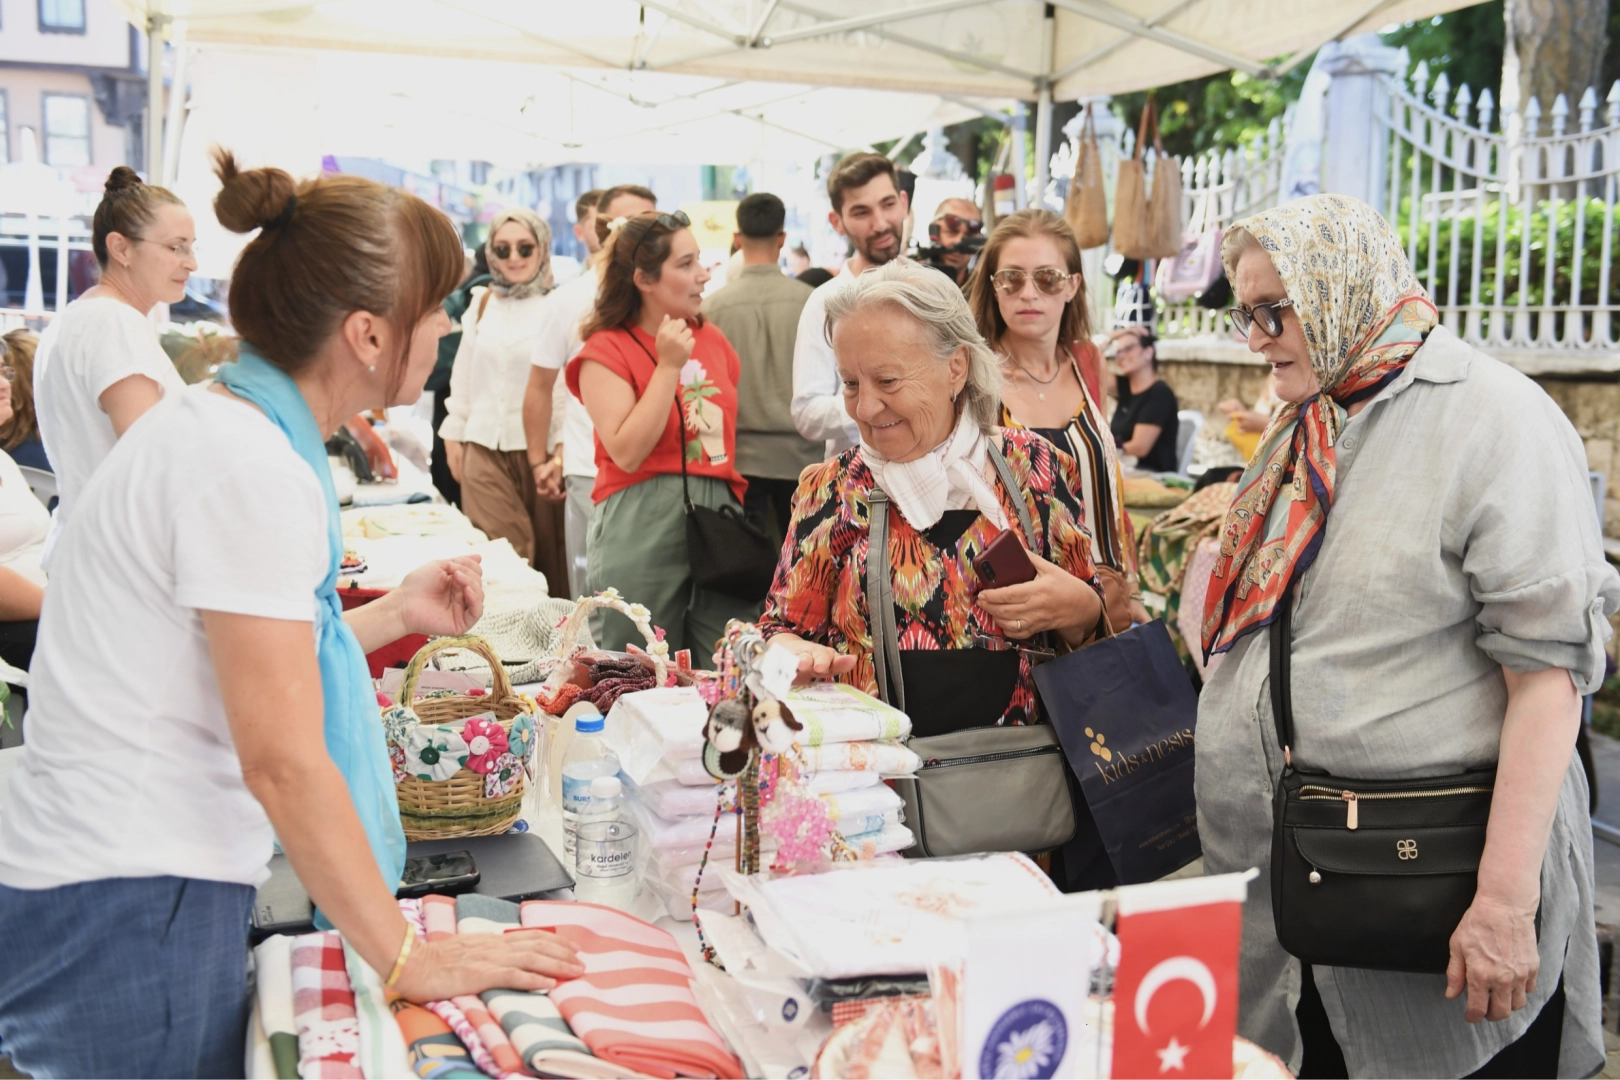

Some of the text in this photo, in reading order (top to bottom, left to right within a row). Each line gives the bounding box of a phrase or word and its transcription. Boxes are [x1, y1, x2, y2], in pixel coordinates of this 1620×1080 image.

[1095, 751, 1140, 785] kids
[1146, 728, 1195, 763] nests
[590, 850, 632, 863] kardelen
